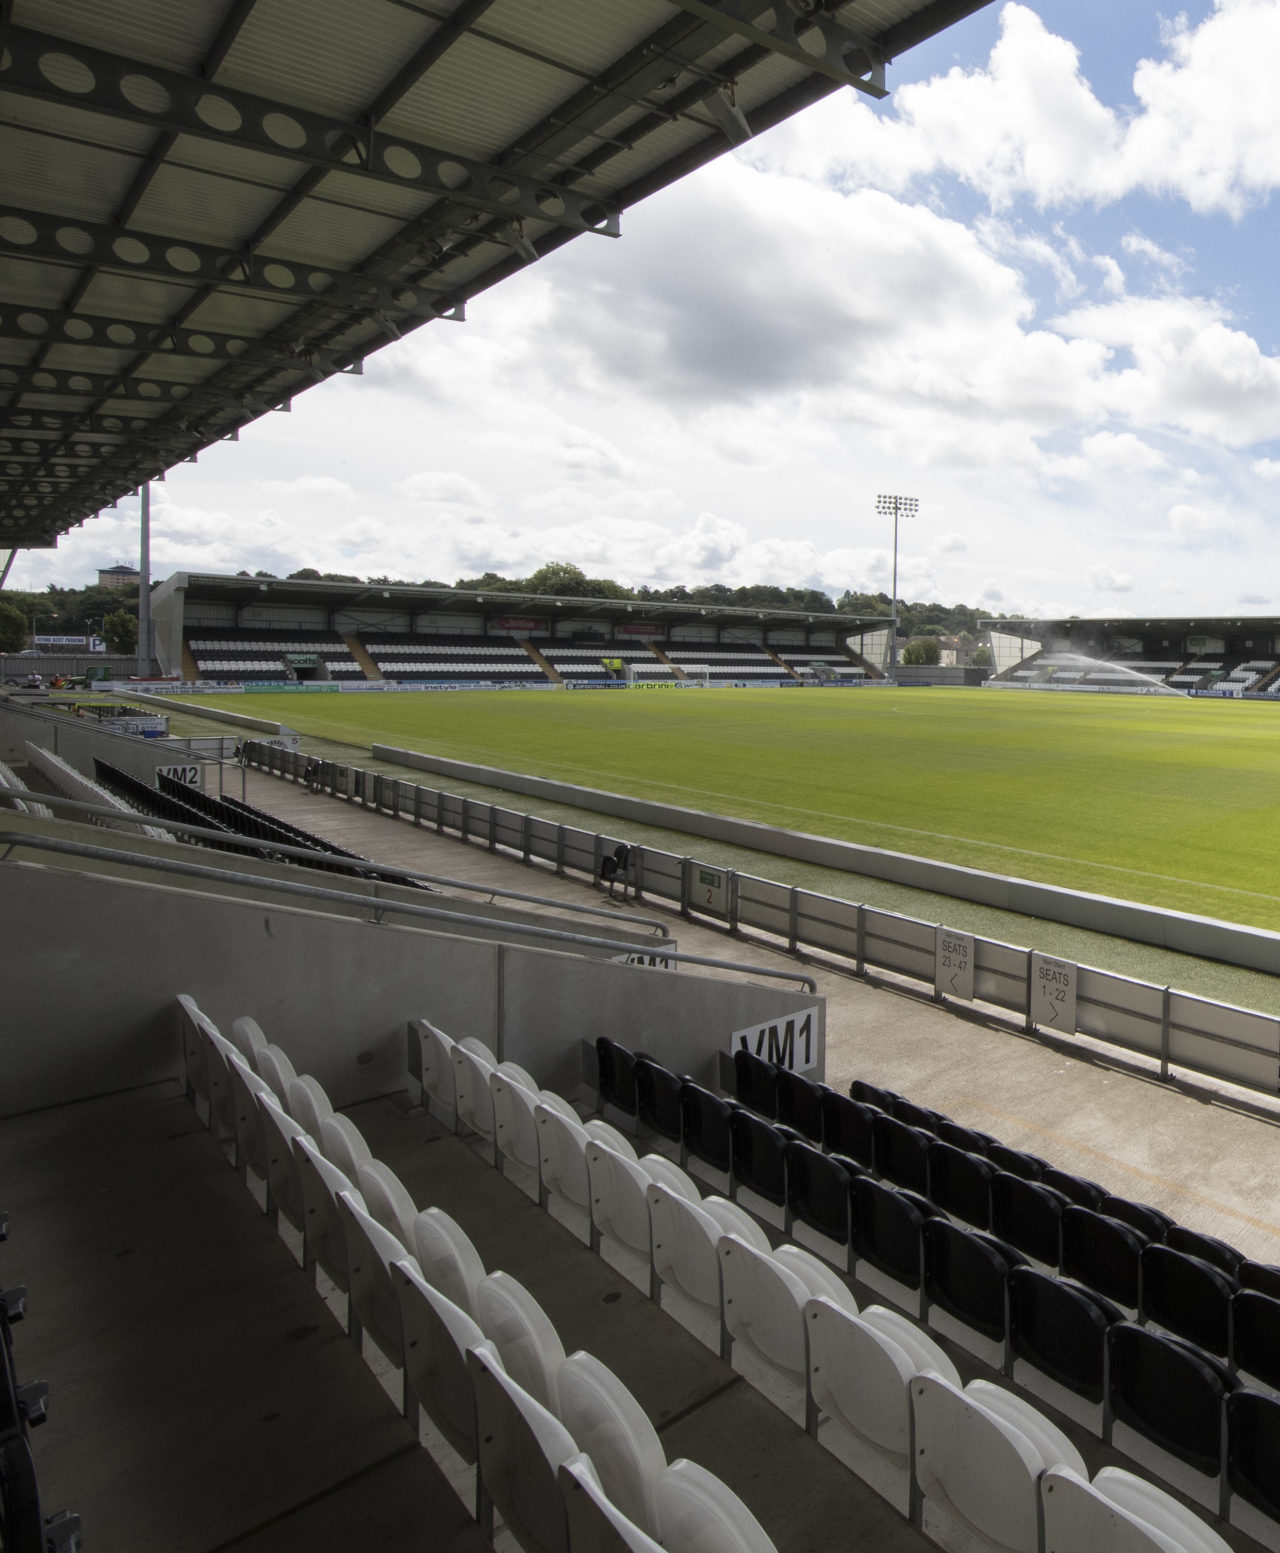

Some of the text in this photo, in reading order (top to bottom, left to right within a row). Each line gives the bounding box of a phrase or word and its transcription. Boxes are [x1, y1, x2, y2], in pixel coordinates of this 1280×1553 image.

[65, 636, 84, 644] PARKING
[92, 638, 103, 651] P
[706, 888, 713, 904] 2
[942, 939, 968, 958] SEATS
[942, 955, 951, 968] 23
[958, 960, 967, 973] 47
[1038, 966, 1069, 987] SEATS
[1055, 989, 1066, 1002] 22
[739, 1013, 812, 1071] VM1
